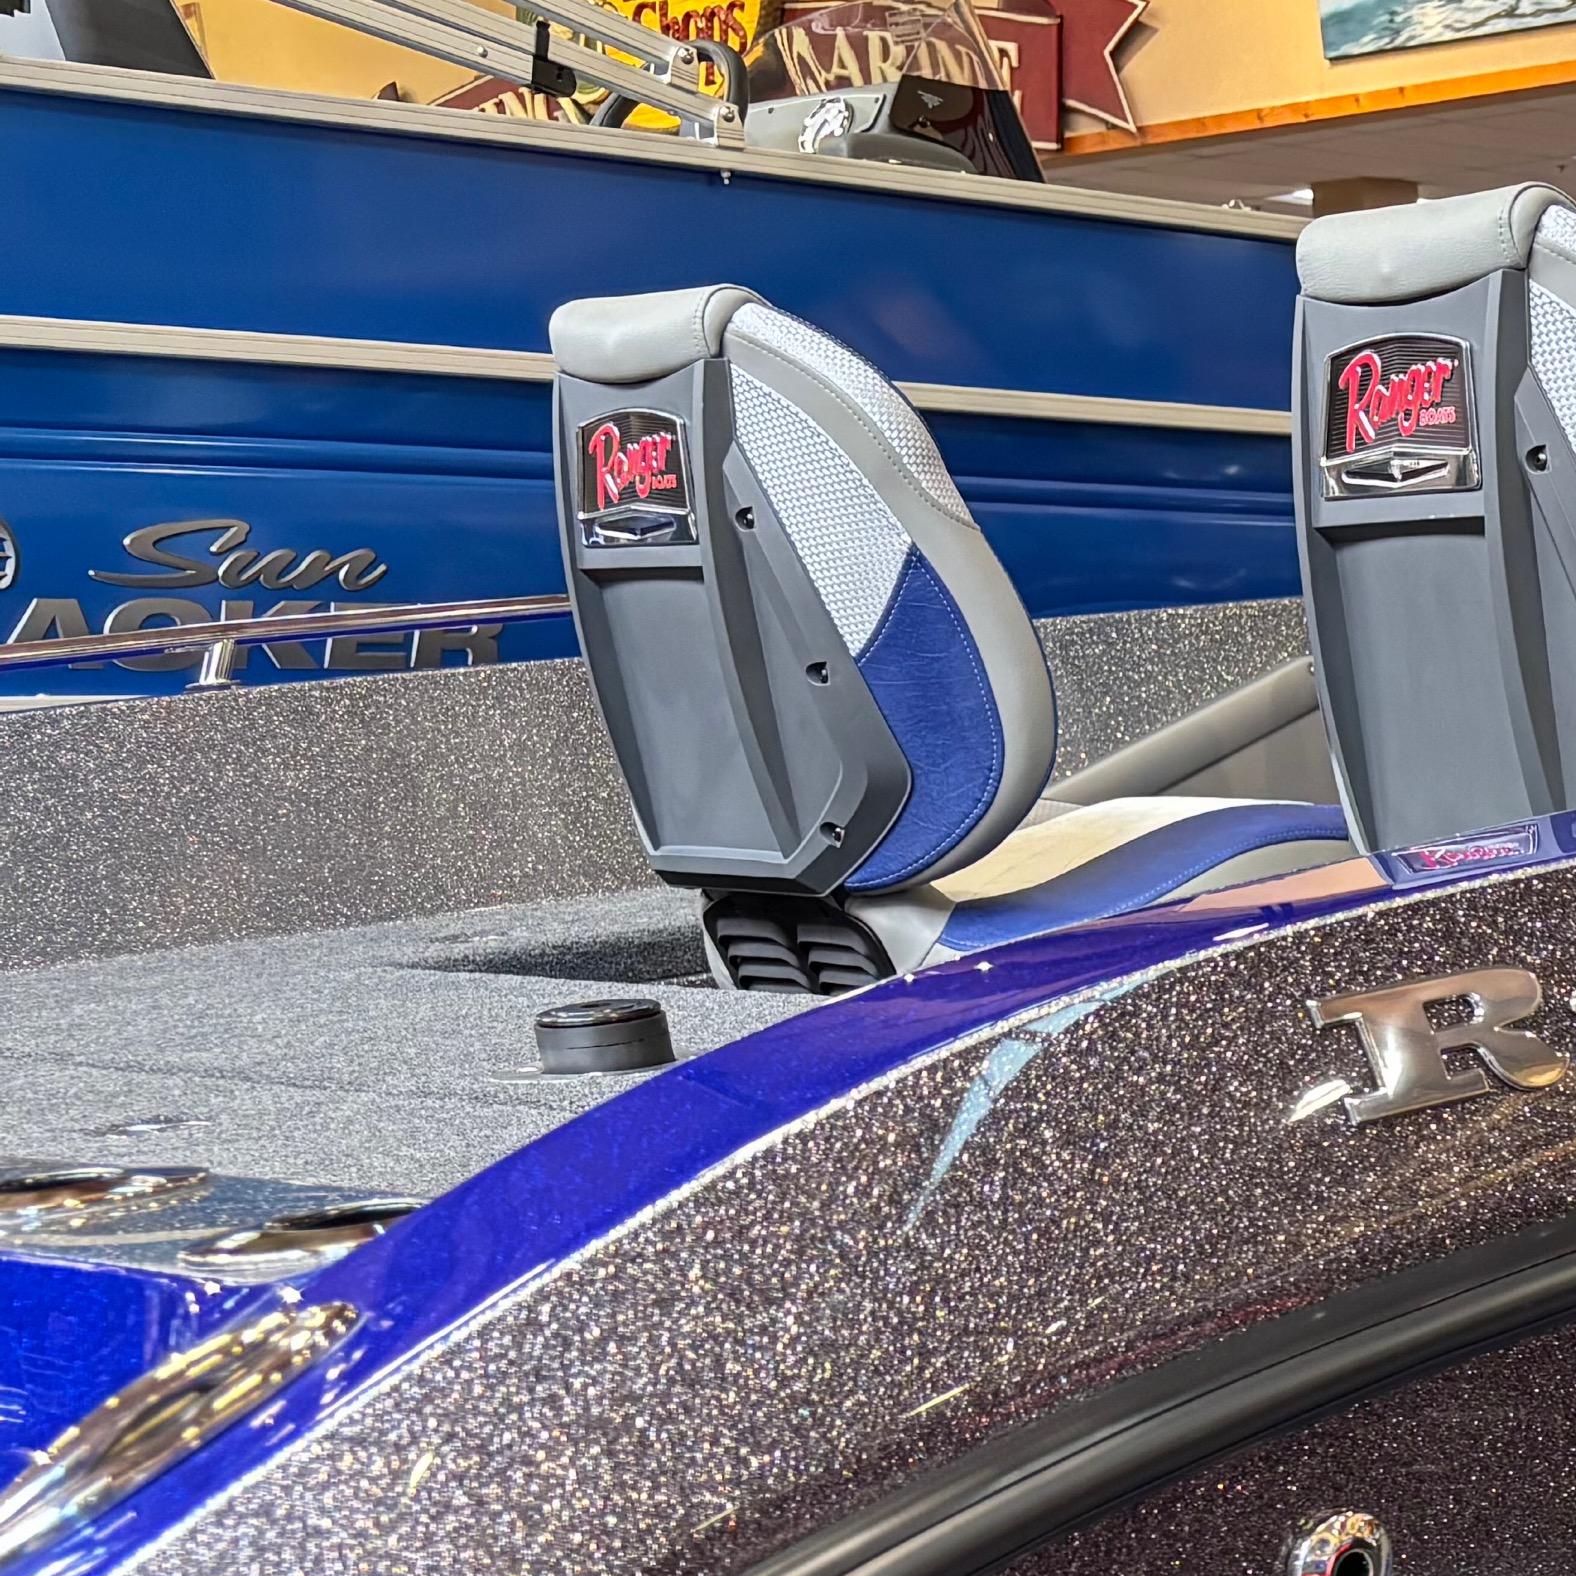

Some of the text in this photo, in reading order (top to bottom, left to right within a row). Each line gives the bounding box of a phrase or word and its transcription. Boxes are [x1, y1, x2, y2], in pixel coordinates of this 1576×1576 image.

[1338, 350, 1452, 453] Ranger
[587, 421, 672, 512] Ranger
[88, 518, 388, 591] Sun
